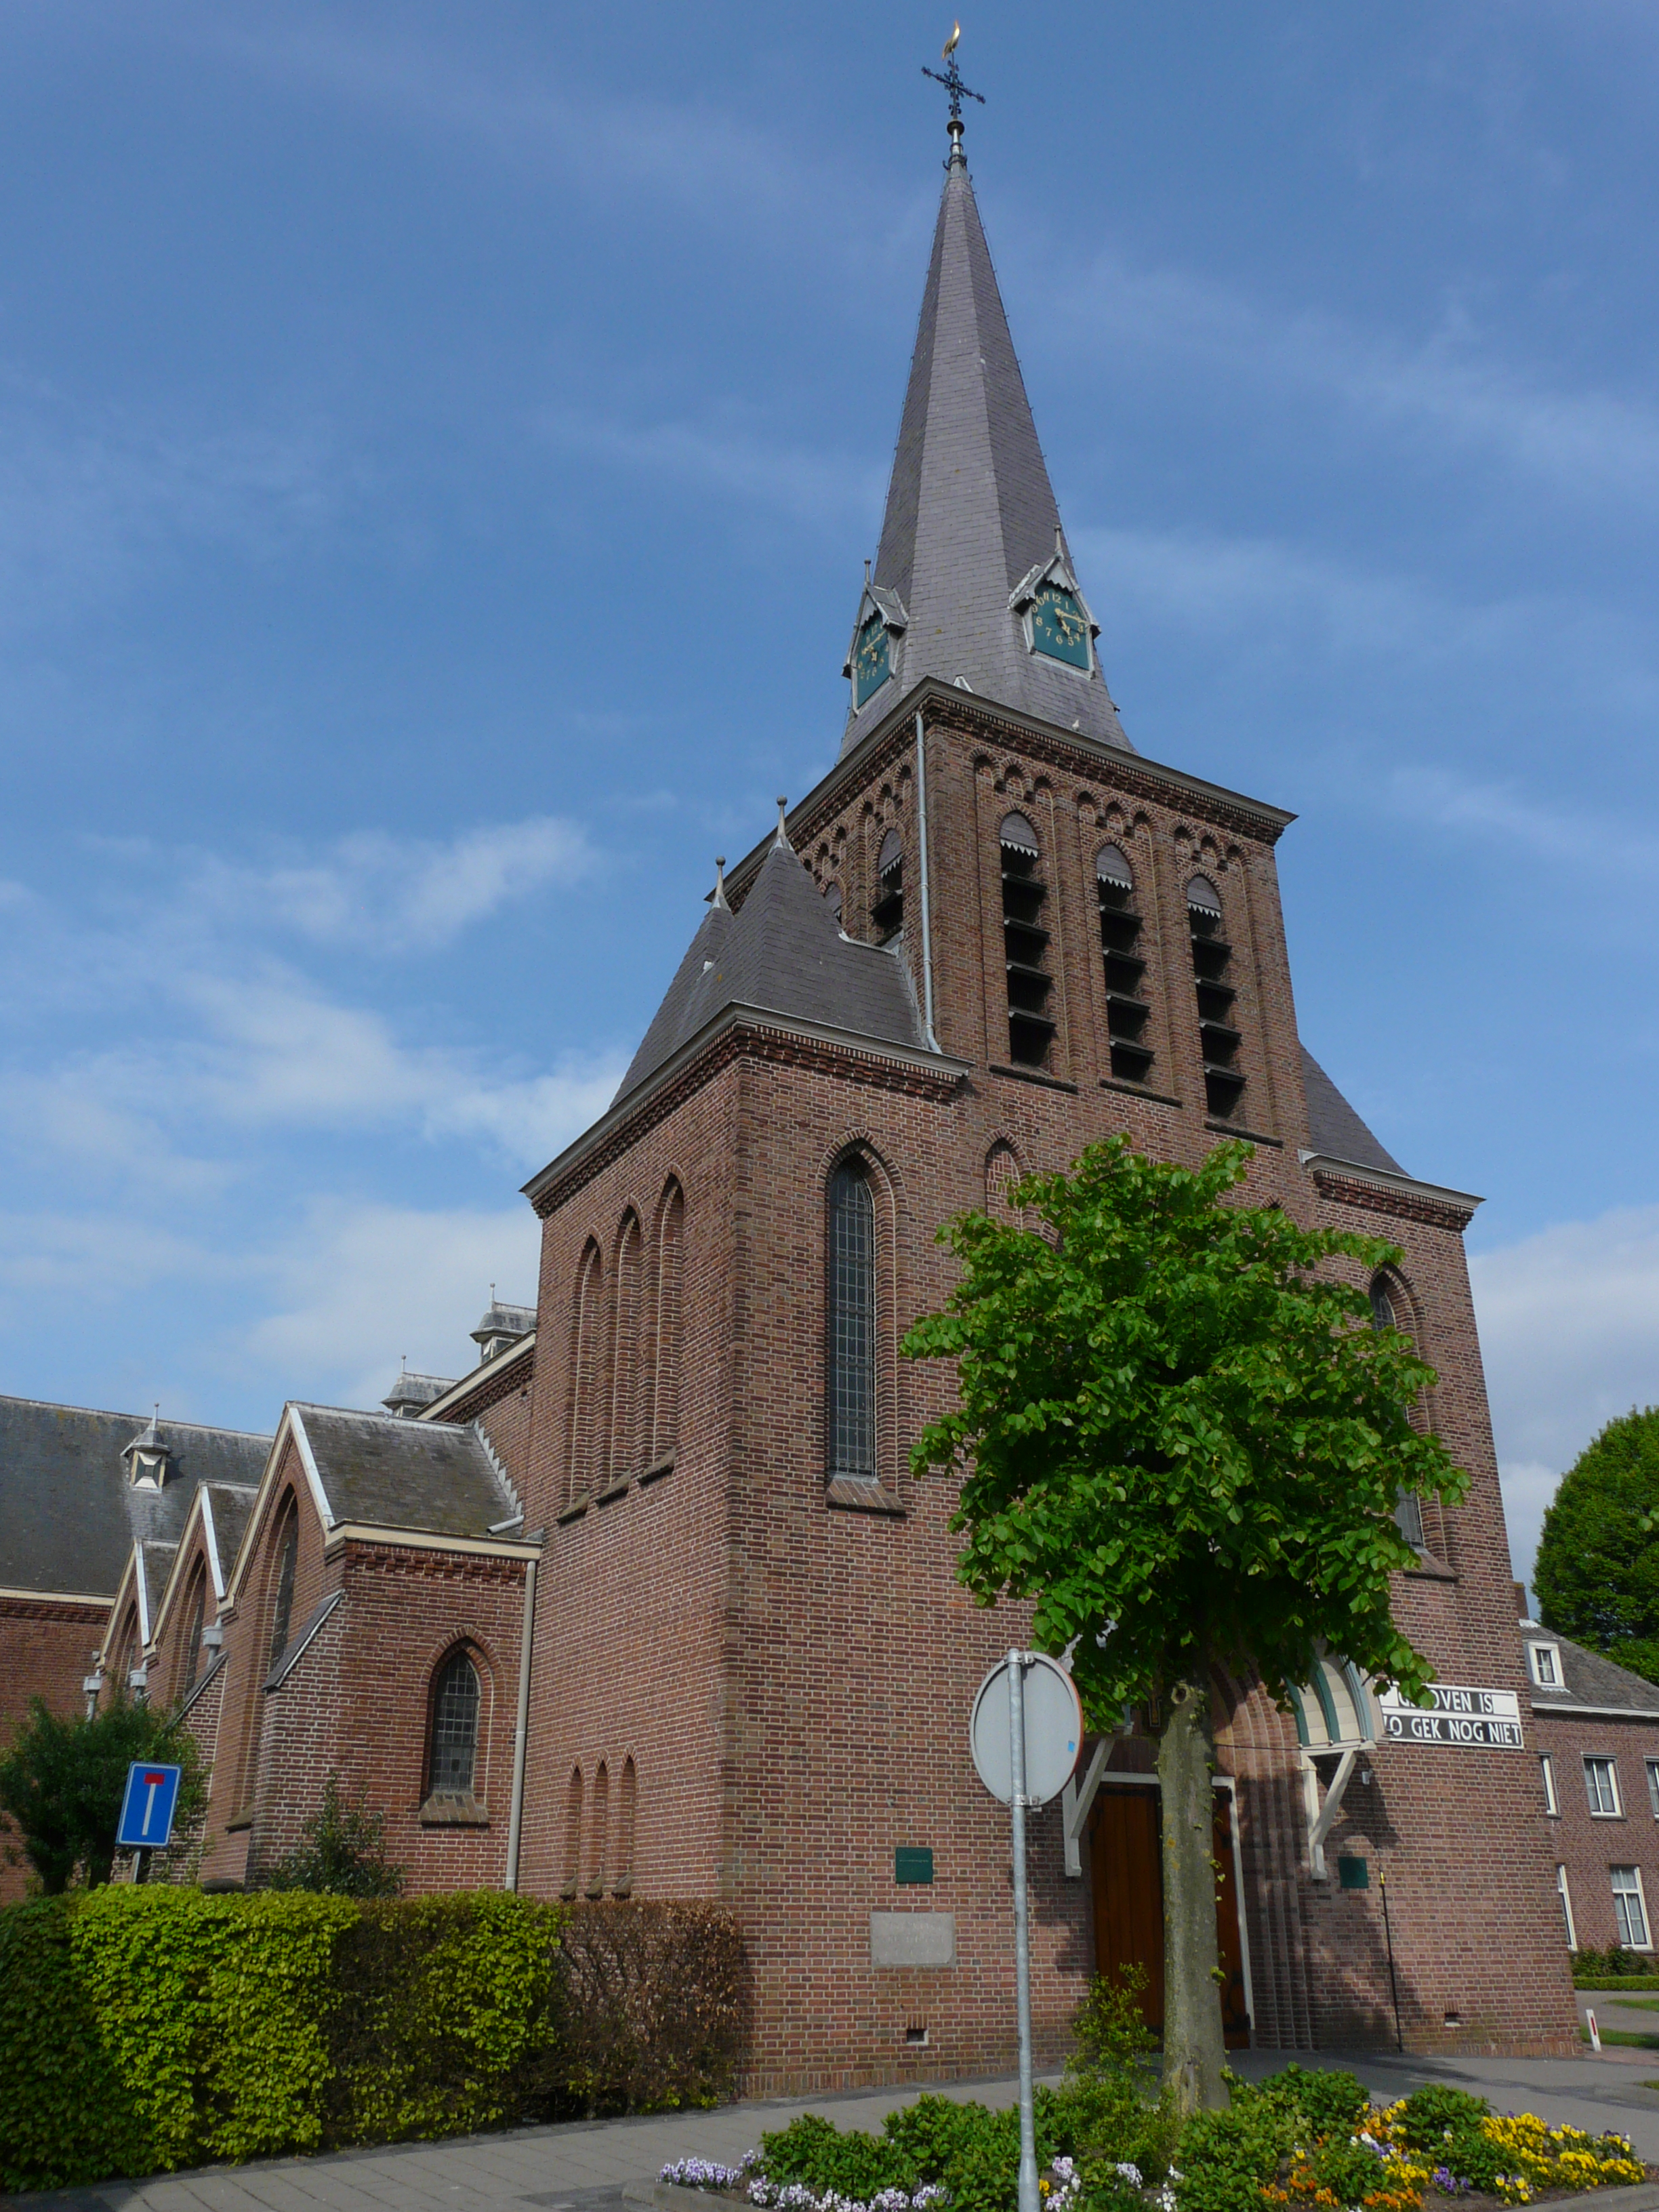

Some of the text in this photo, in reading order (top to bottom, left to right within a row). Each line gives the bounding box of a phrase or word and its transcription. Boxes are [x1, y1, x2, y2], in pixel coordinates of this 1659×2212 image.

[1052, 593, 1061, 604] 12
[1046, 628, 1052, 636] 7
[1056, 635, 1063, 644] 6
[1479, 1694, 1492, 1713] IS
[1411, 1717, 1442, 1738] GEK
[1449, 1720, 1484, 1741] NOG
[1488, 1723, 1519, 1744] NIET
